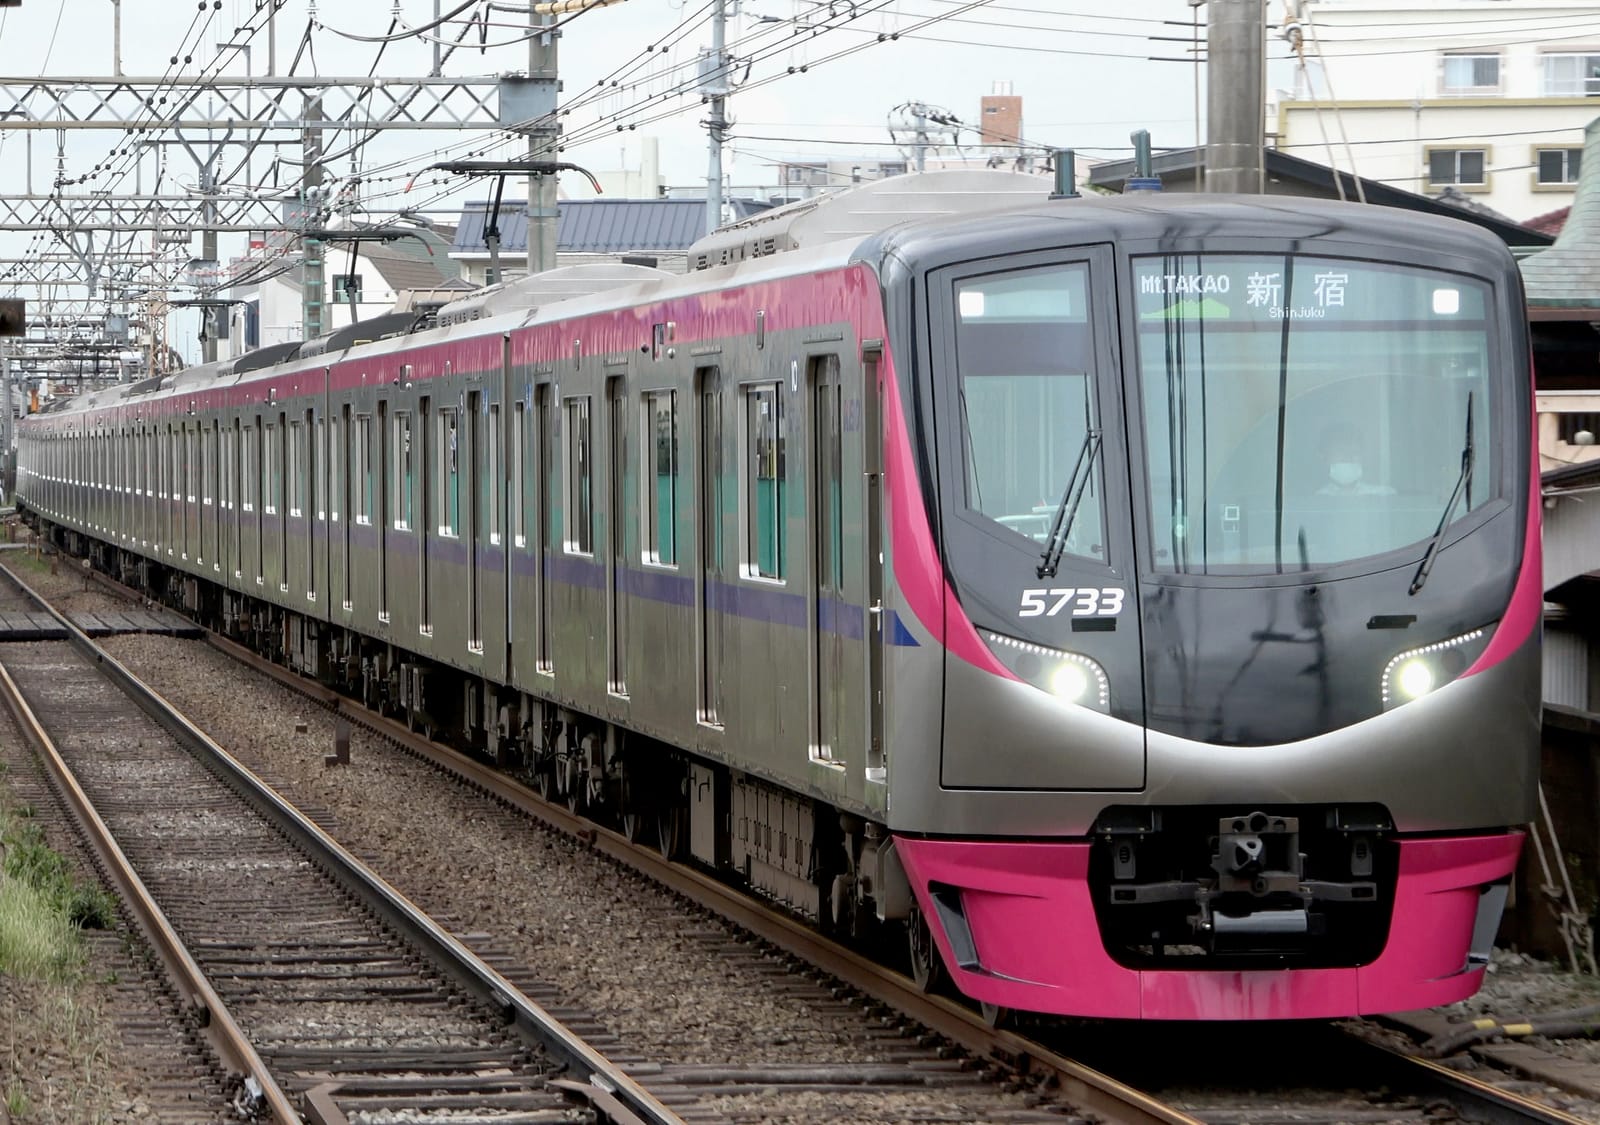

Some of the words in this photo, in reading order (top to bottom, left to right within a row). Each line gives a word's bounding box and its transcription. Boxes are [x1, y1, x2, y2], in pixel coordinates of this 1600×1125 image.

[1141, 275, 1230, 294] Mt.TAKAO
[1269, 306, 1325, 319] Shinjuku
[1018, 588, 1125, 617] 5733
